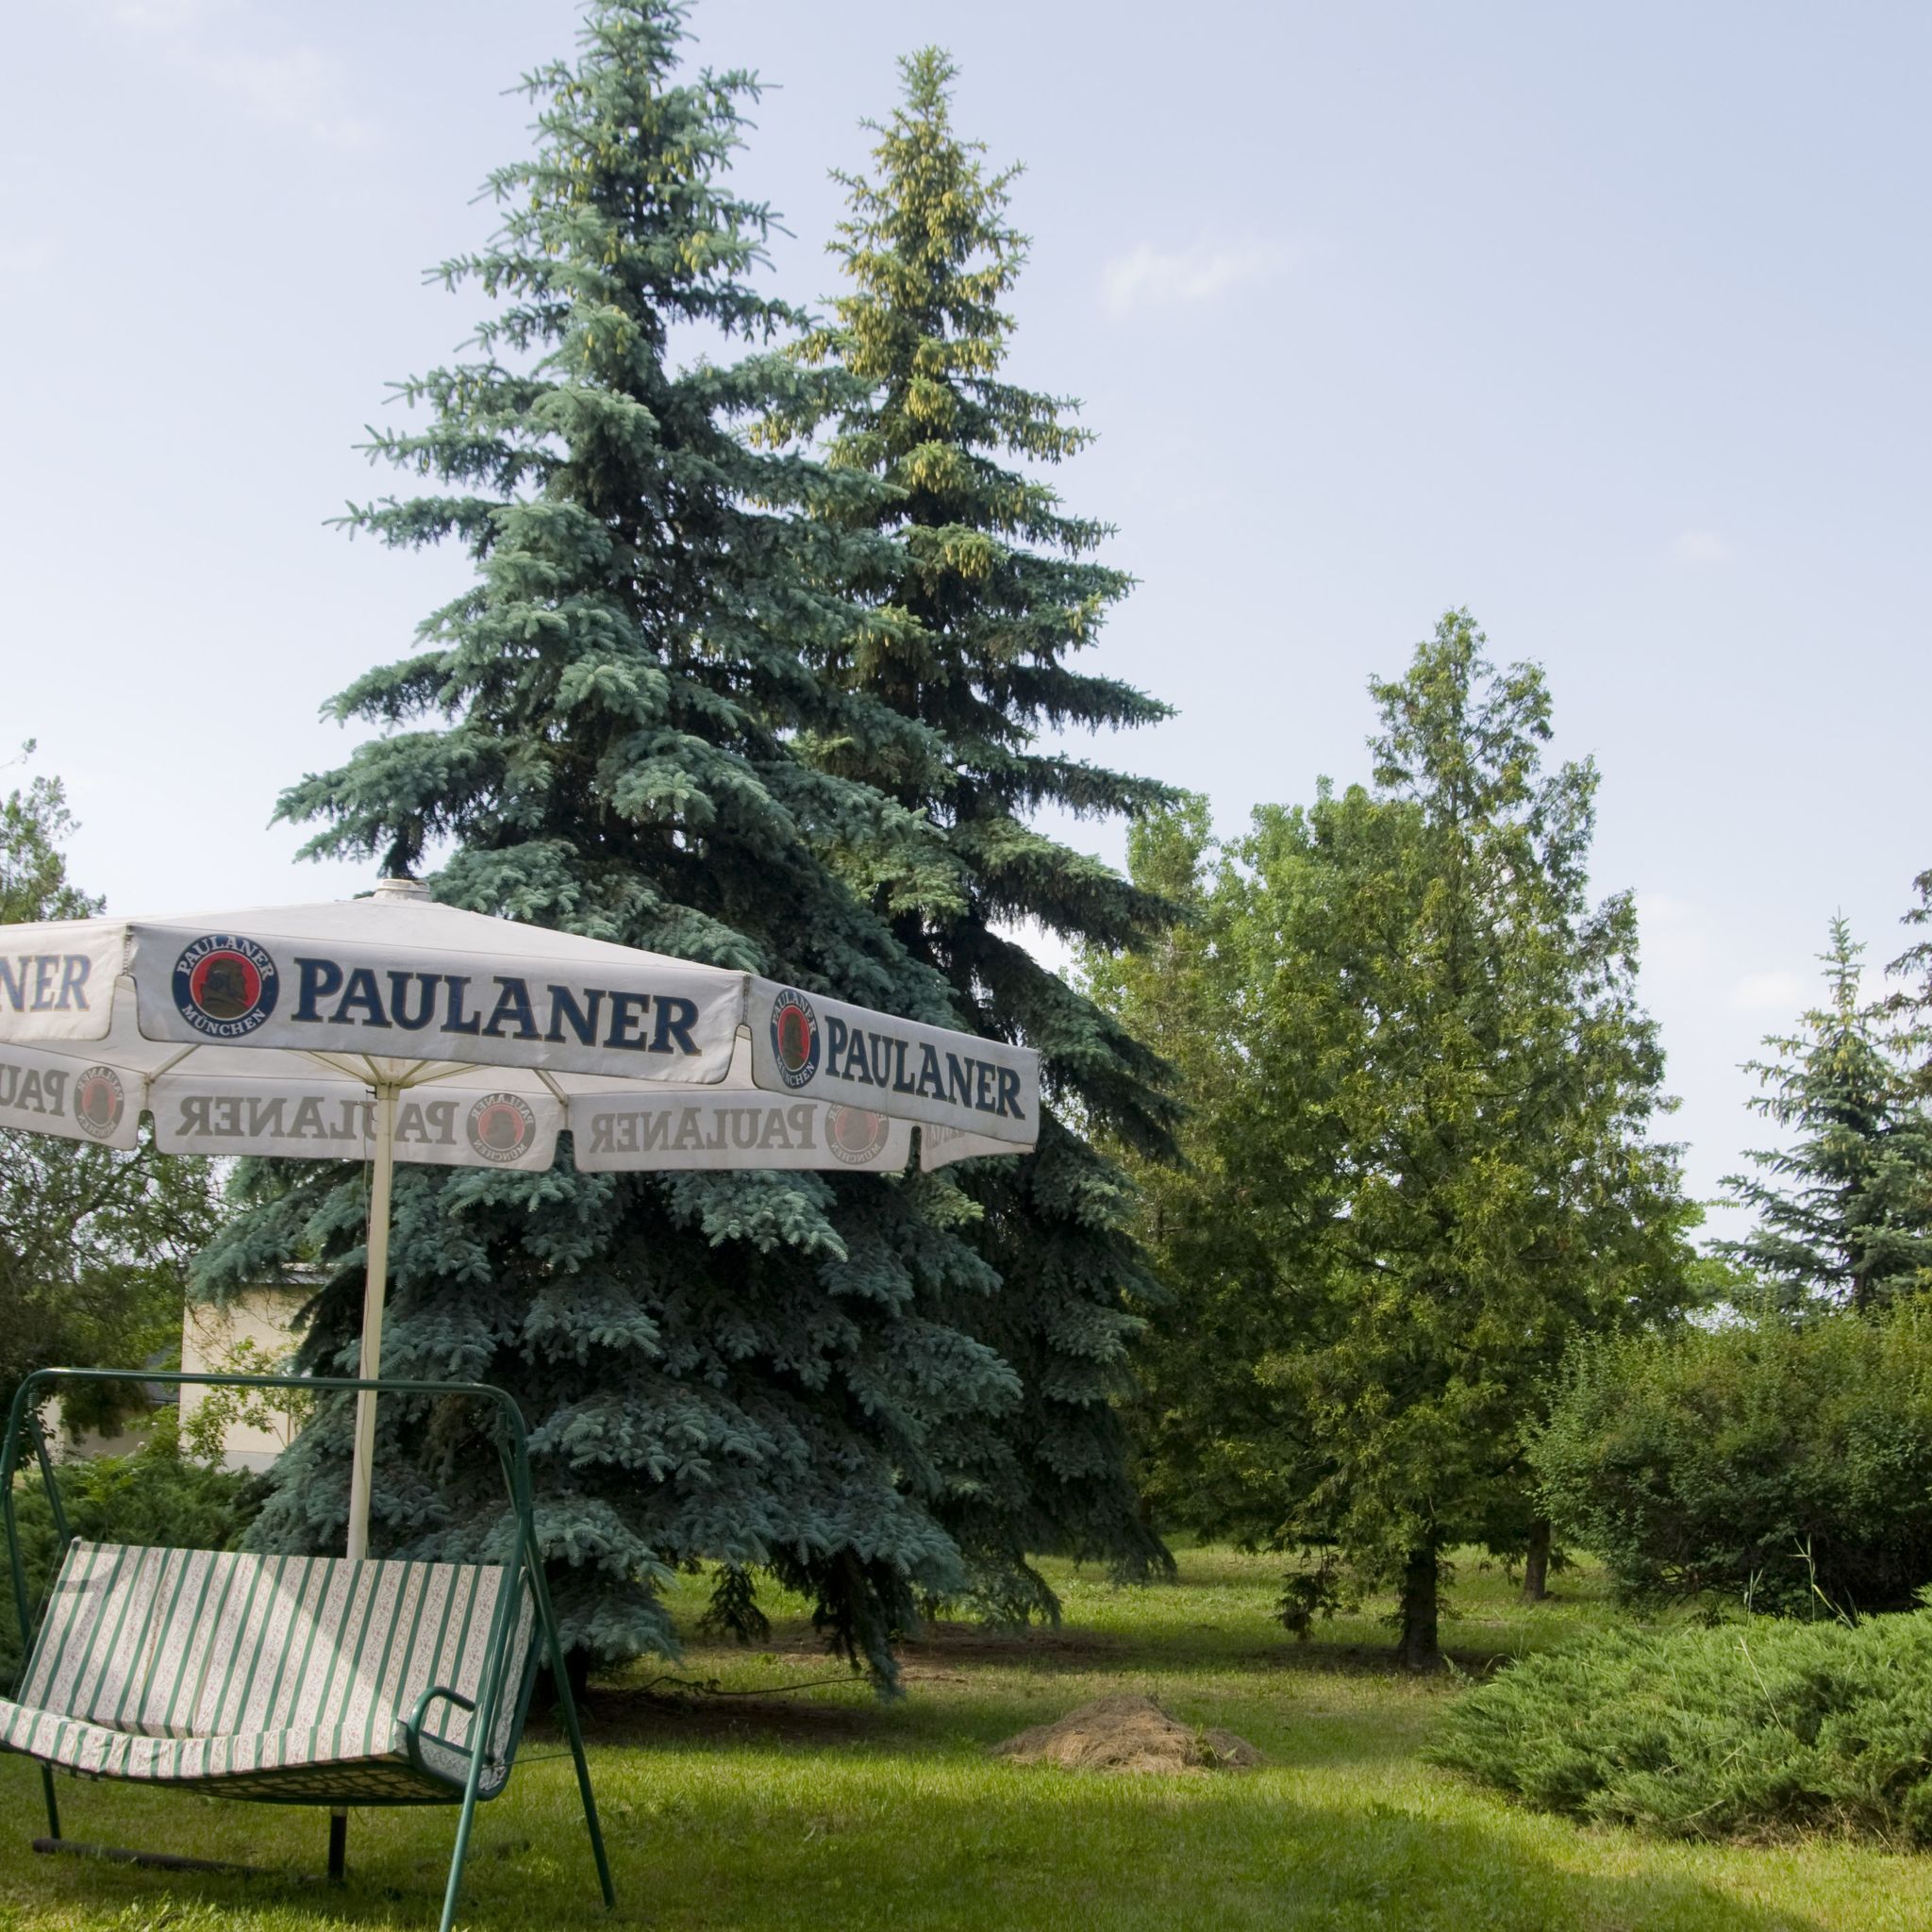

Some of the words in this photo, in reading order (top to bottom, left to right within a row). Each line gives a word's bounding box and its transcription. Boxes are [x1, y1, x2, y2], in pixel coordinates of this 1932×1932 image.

[0, 954, 92, 1012] NER
[176, 935, 275, 981] PAULANER
[182, 1004, 266, 1036] MÜNCHEN
[291, 957, 703, 1057] PAULANER
[772, 991, 817, 1036] PAULANER
[824, 1015, 1025, 1121] PAULANER
